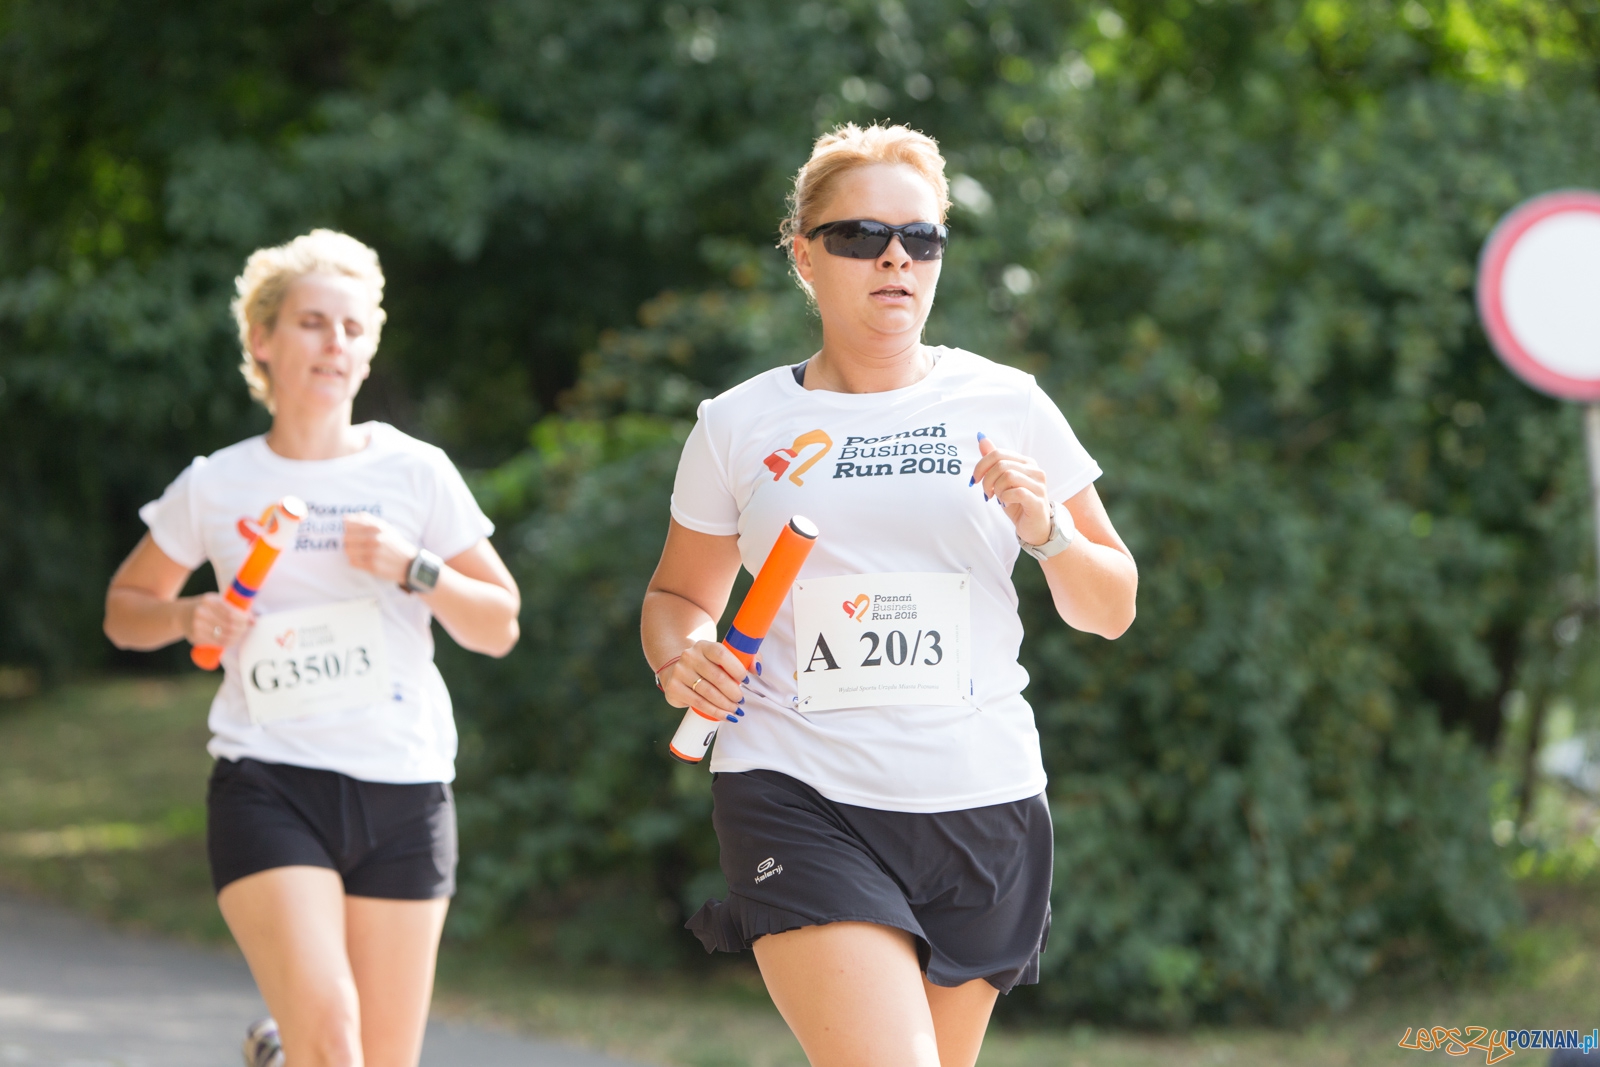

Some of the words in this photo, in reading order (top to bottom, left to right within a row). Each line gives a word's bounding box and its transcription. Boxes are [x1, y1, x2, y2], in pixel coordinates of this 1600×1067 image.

[843, 422, 948, 447] Poznań
[837, 441, 958, 460] Business
[832, 461, 893, 479] Run
[899, 457, 962, 475] 2016
[872, 602, 917, 612] Business
[873, 593, 912, 603] Poznań
[871, 612, 893, 620] Run
[894, 611, 918, 620] 2016
[803, 631, 842, 673] A
[859, 629, 943, 667] 20/3
[251, 646, 372, 693] G350/3
